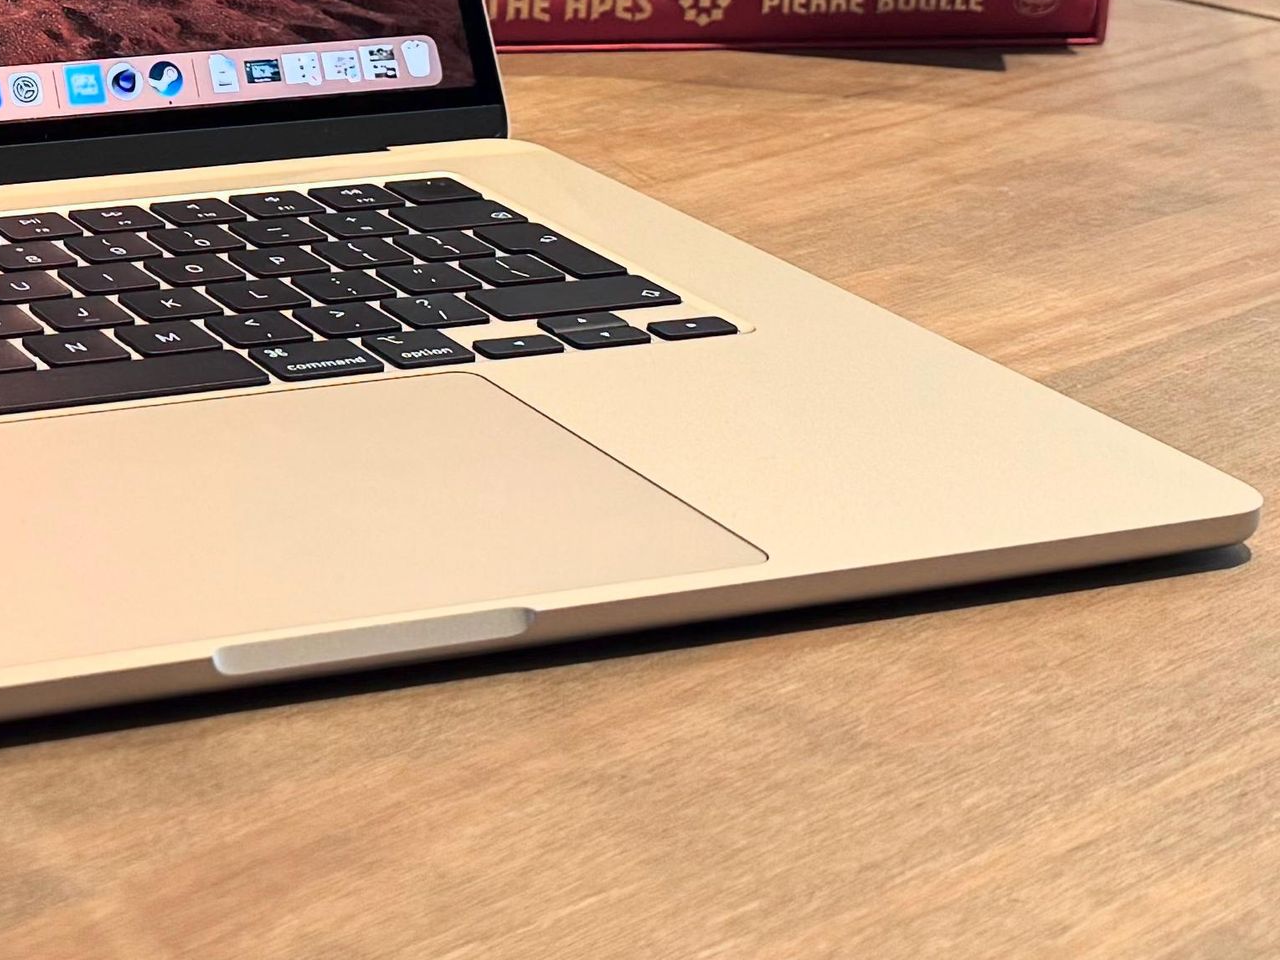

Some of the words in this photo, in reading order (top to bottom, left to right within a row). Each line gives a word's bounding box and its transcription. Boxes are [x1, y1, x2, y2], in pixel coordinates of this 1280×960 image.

[194, 238, 211, 247] 0
[25, 255, 42, 264] 8
[268, 256, 285, 265] P
[184, 264, 204, 273] O
[10, 281, 31, 291] U
[248, 290, 269, 299] L
[160, 298, 182, 309] K
[154, 332, 181, 343] M
[64, 342, 88, 353] N
[401, 347, 453, 358] option
[286, 355, 366, 371] command
